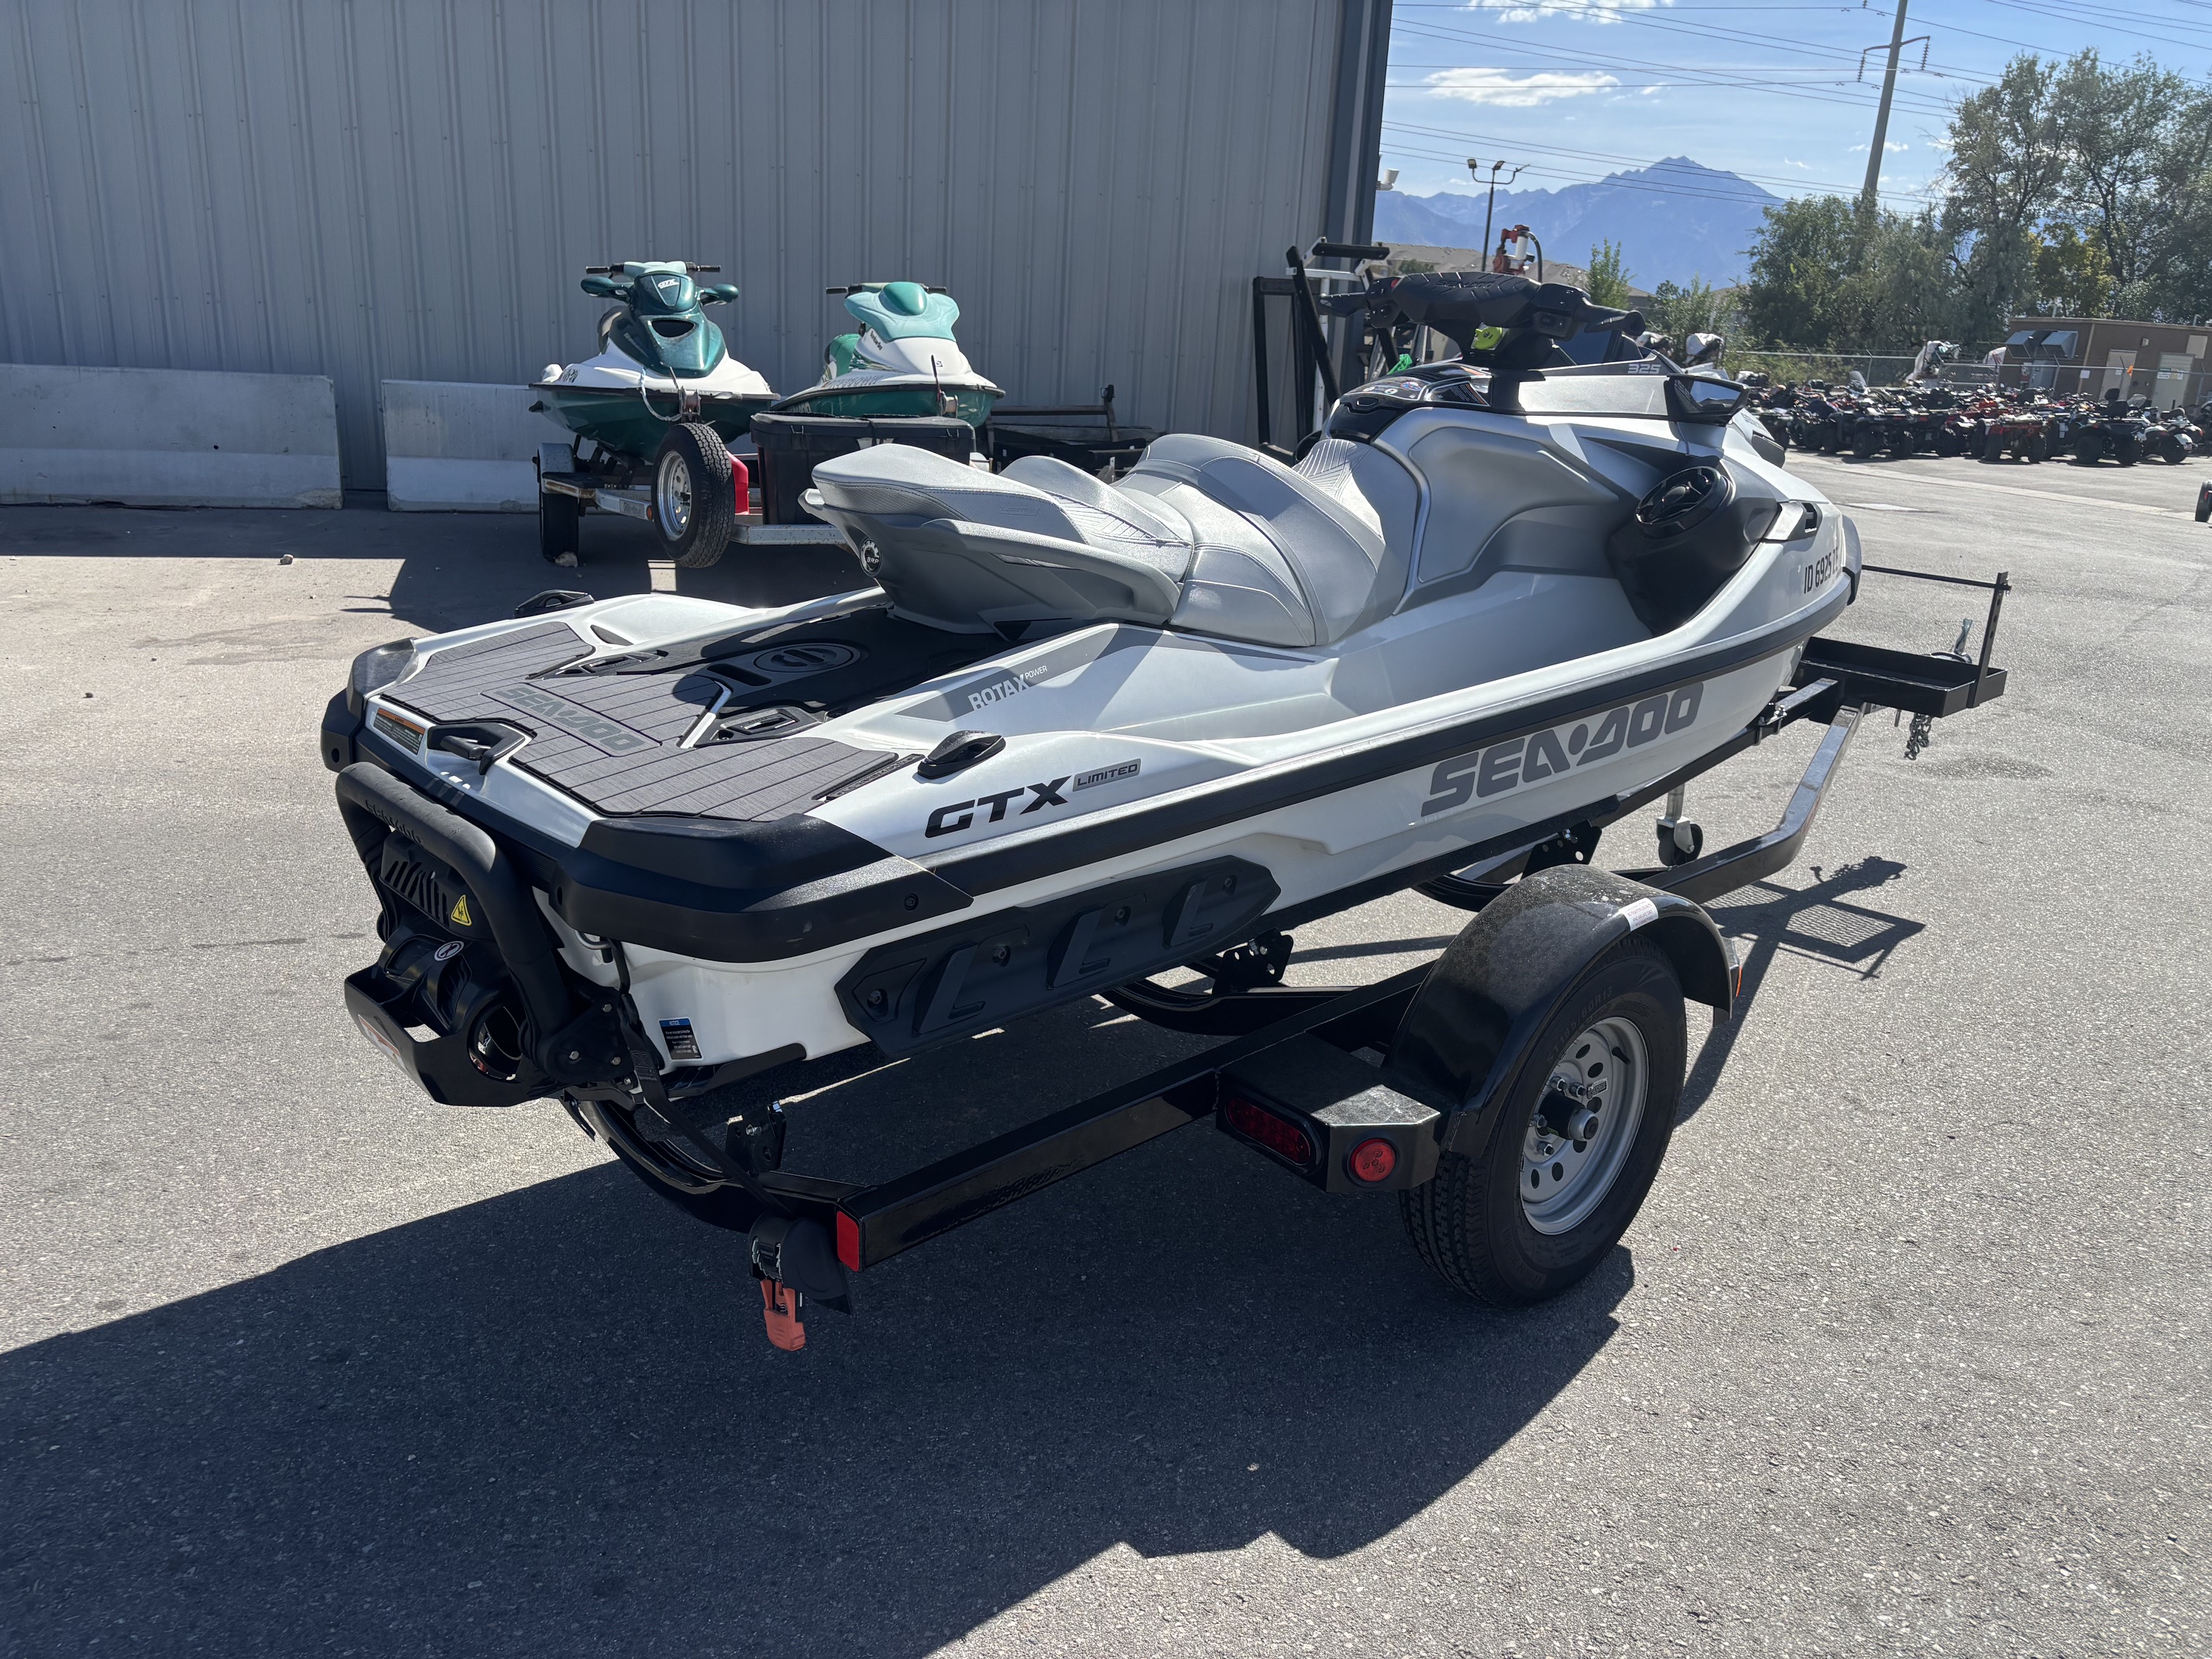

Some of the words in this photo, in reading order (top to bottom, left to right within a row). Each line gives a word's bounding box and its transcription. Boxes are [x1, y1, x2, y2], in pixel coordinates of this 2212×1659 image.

[1627, 363, 1661, 375] 325
[867, 556, 880, 565] BRP
[1804, 565, 1813, 594] ID
[1815, 552, 1832, 588] 6925
[967, 674, 1029, 711] ROTAX
[1025, 665, 1048, 679] POWER
[925, 775, 1072, 838] GTX
[1077, 763, 1139, 786] LIMITED
